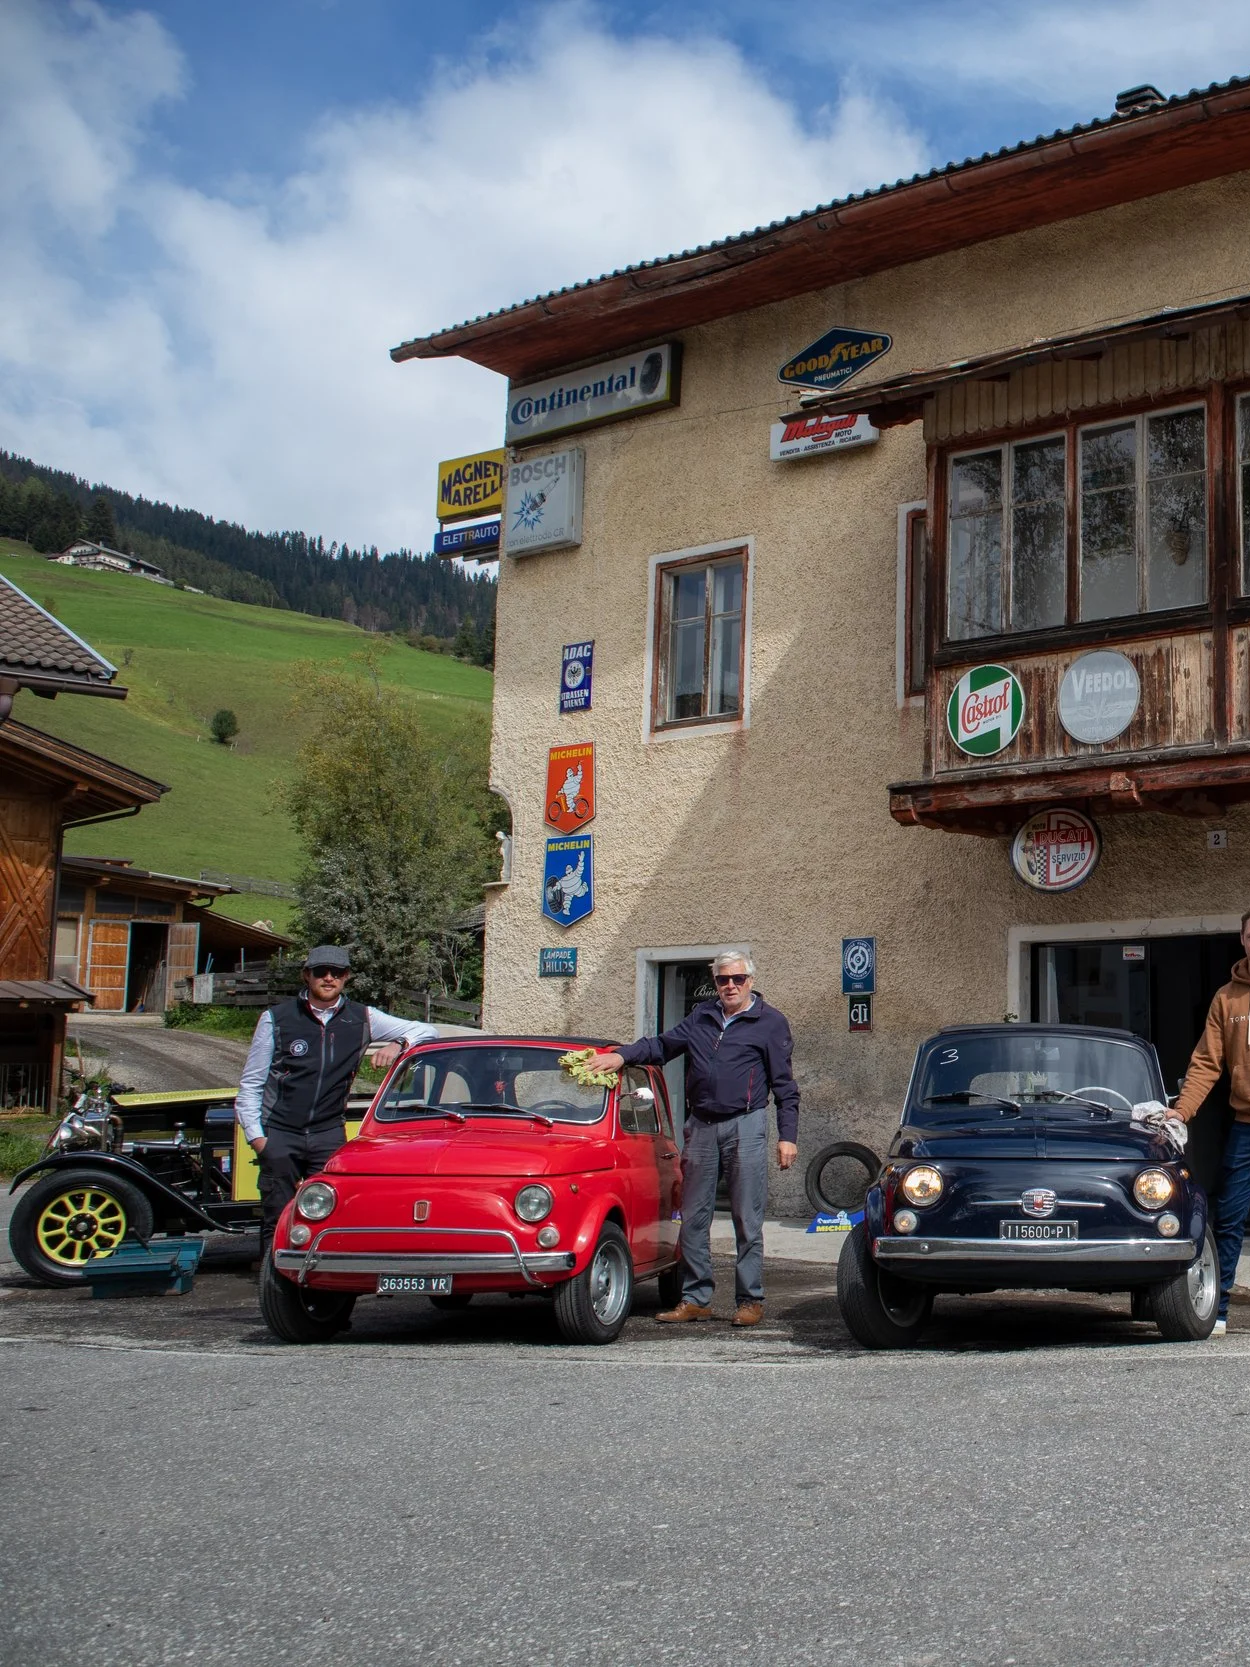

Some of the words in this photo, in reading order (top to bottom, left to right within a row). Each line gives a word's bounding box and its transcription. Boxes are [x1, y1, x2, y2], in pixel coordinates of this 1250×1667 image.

[783, 338, 883, 378] GOODYEAR
[814, 366, 852, 383] PNEUMATICI
[510, 366, 636, 425] Continental
[834, 429, 852, 438] MOTO
[780, 447, 800, 456] VENDITA
[804, 440, 835, 451] ASSISTENZA
[839, 434, 861, 444] RICAMBI
[510, 455, 566, 486] BOSCH
[443, 525, 499, 546] ELETTRAUTO
[563, 644, 591, 661] ADAC
[1071, 669, 1134, 701] VEEDOL
[560, 688, 589, 700] STRASSEN
[563, 697, 585, 708] DIENST
[961, 682, 1010, 734] Castrol
[550, 747, 592, 761] MICHELIN
[1040, 829, 1088, 845] DUCATI
[1214, 834, 1220, 845] 2
[548, 839, 590, 852] MICHELIN
[1052, 852, 1086, 864] SERVIZIO
[543, 950, 572, 960] LAMPADE
[940, 1048, 959, 1065] 3
[1007, 1225, 1050, 1238] 115600
[382, 1278, 425, 1290] 363553
[431, 1278, 446, 1290] VR
